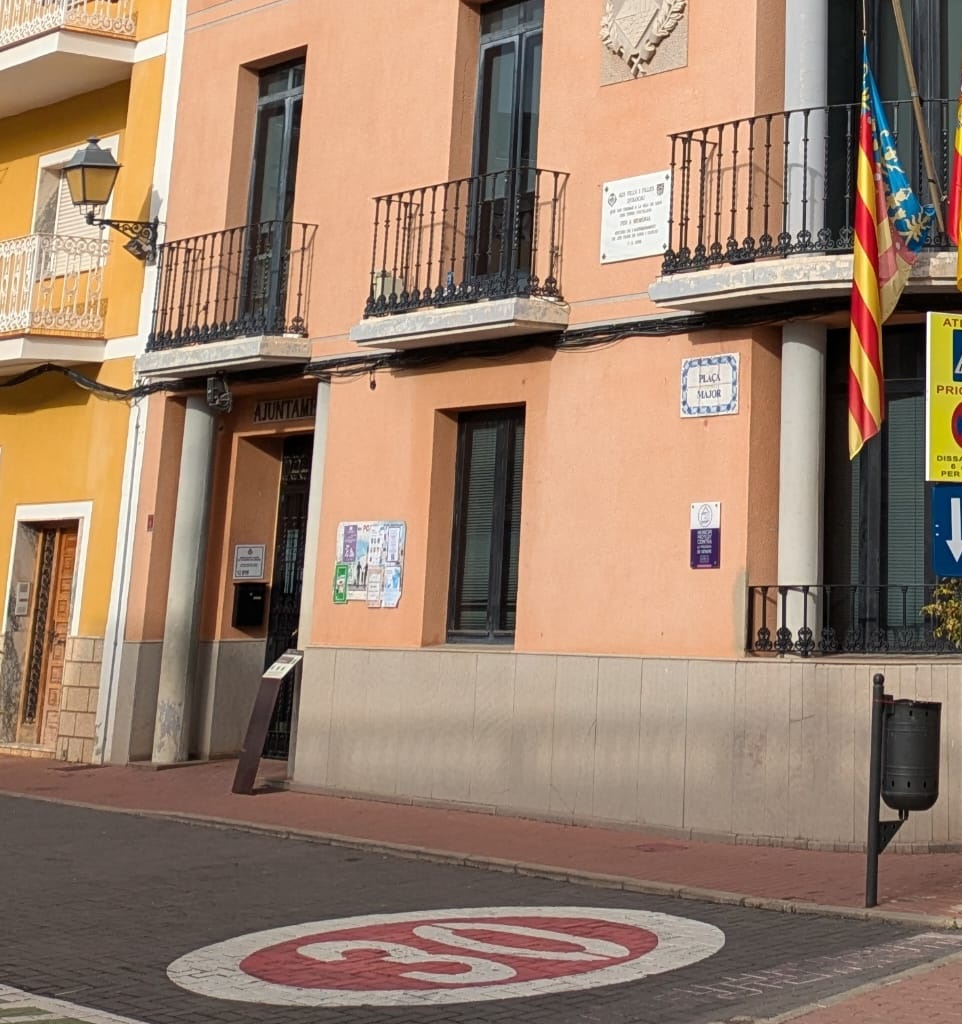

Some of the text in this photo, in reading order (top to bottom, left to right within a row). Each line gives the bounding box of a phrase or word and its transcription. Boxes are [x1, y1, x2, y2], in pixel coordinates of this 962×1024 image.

[699, 373, 721, 383] PLAÇA
[697, 389, 722, 399] MAJOR
[941, 470, 960, 478] PER
[296, 922, 630, 984] 30
